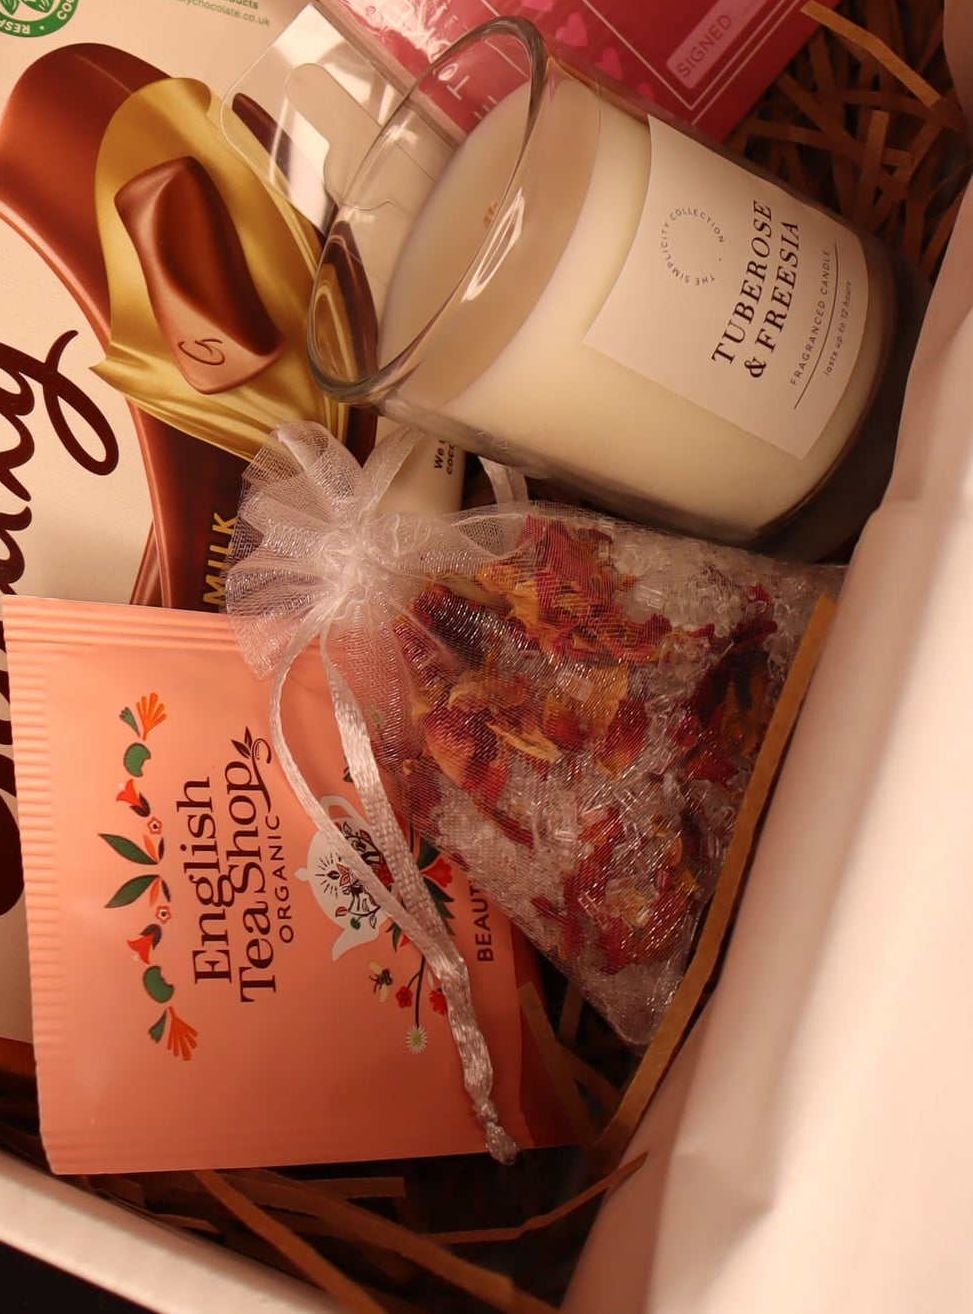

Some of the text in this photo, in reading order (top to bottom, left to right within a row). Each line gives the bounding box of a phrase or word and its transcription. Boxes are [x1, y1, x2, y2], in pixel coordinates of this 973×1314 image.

[660, 207, 726, 286] THE SIMPLICITY COLLECTION
[711, 200, 774, 365] TUBEROSE
[744, 220, 801, 379] & FREESIA
[789, 299, 826, 387] FRAGRANCED
[835, 335, 844, 349] up
[838, 322, 846, 334] to
[823, 351, 839, 376] lasts
[202, 512, 238, 606] MILK
[176, 775, 236, 985] English
[265, 814, 294, 944] ORGANIC
